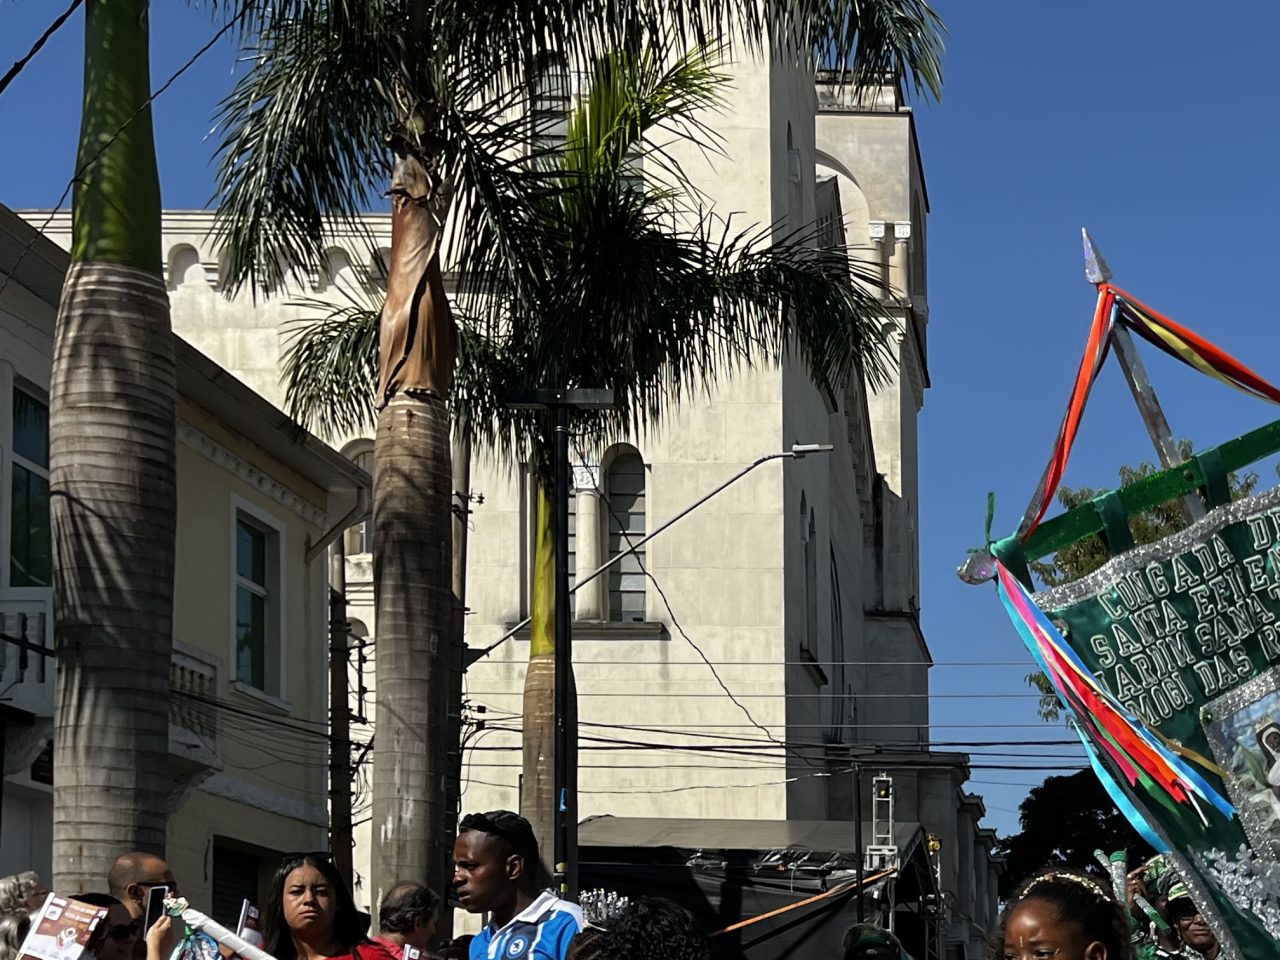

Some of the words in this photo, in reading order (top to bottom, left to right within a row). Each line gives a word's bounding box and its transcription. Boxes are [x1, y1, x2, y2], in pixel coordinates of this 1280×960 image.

[1098, 534, 1235, 620] CONGADA
[1091, 600, 1188, 668] SANTA
[1193, 645, 1254, 696] DAS
